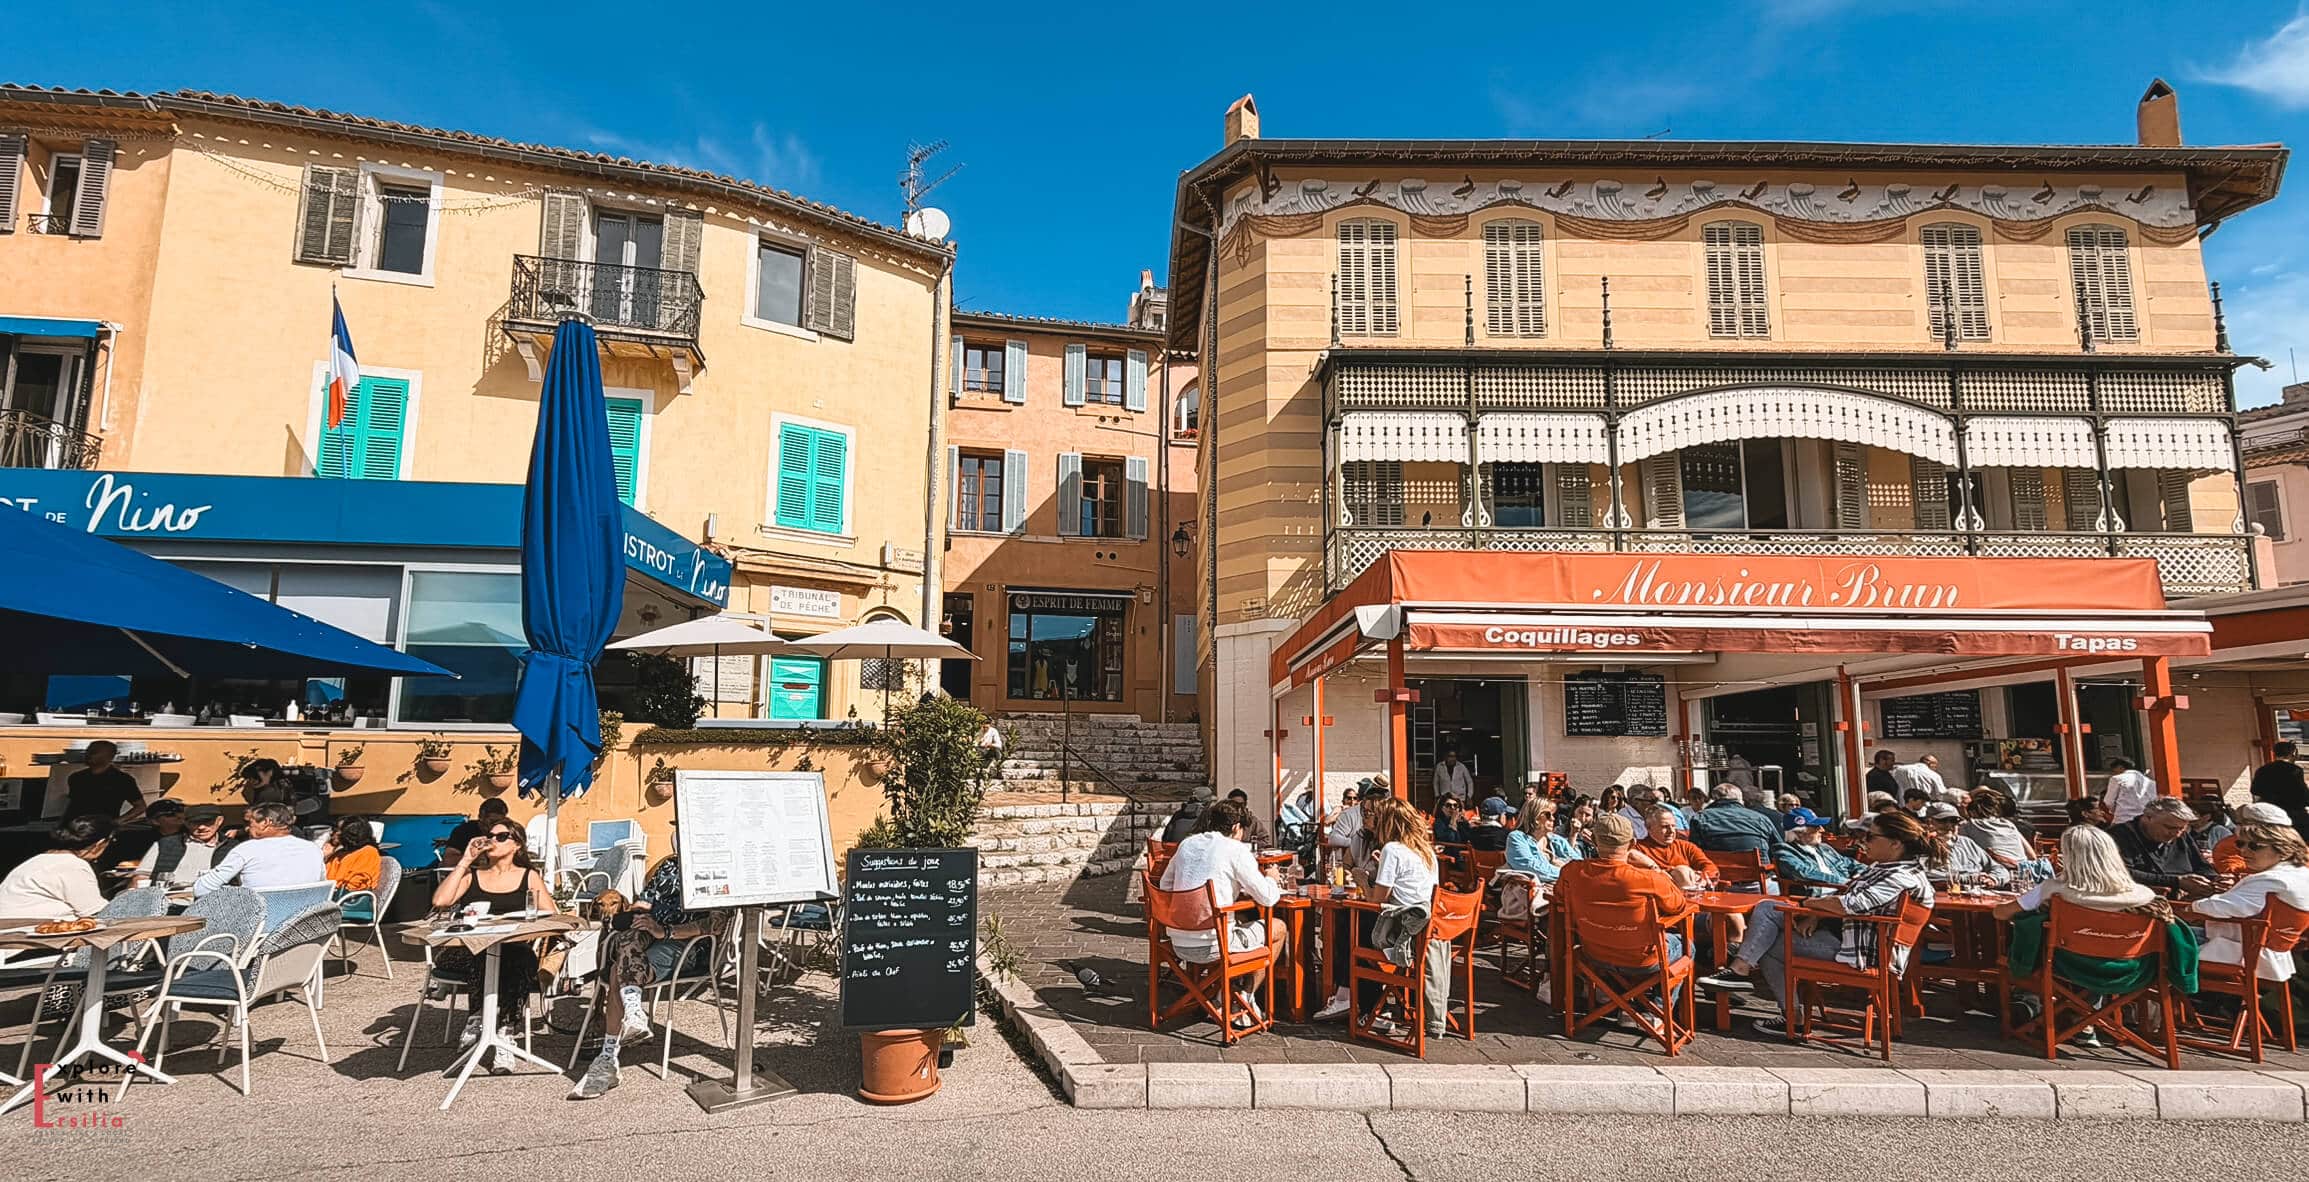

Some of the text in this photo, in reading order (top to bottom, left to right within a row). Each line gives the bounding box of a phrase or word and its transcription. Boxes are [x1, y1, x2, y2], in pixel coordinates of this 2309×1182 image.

[0, 474, 212, 533] T DE Nino
[624, 532, 676, 575] ISTROT
[1593, 559, 1960, 607] Monsieur Brun
[781, 589, 831, 602] TRIBUNAL
[1033, 595, 1122, 611] ESPRIT DE FEMME
[779, 601, 831, 613] DE PÊCHE
[1485, 627, 1641, 648] Coquillages
[2054, 633, 2138, 653] Tapas
[860, 855, 903, 870] Suggestions
